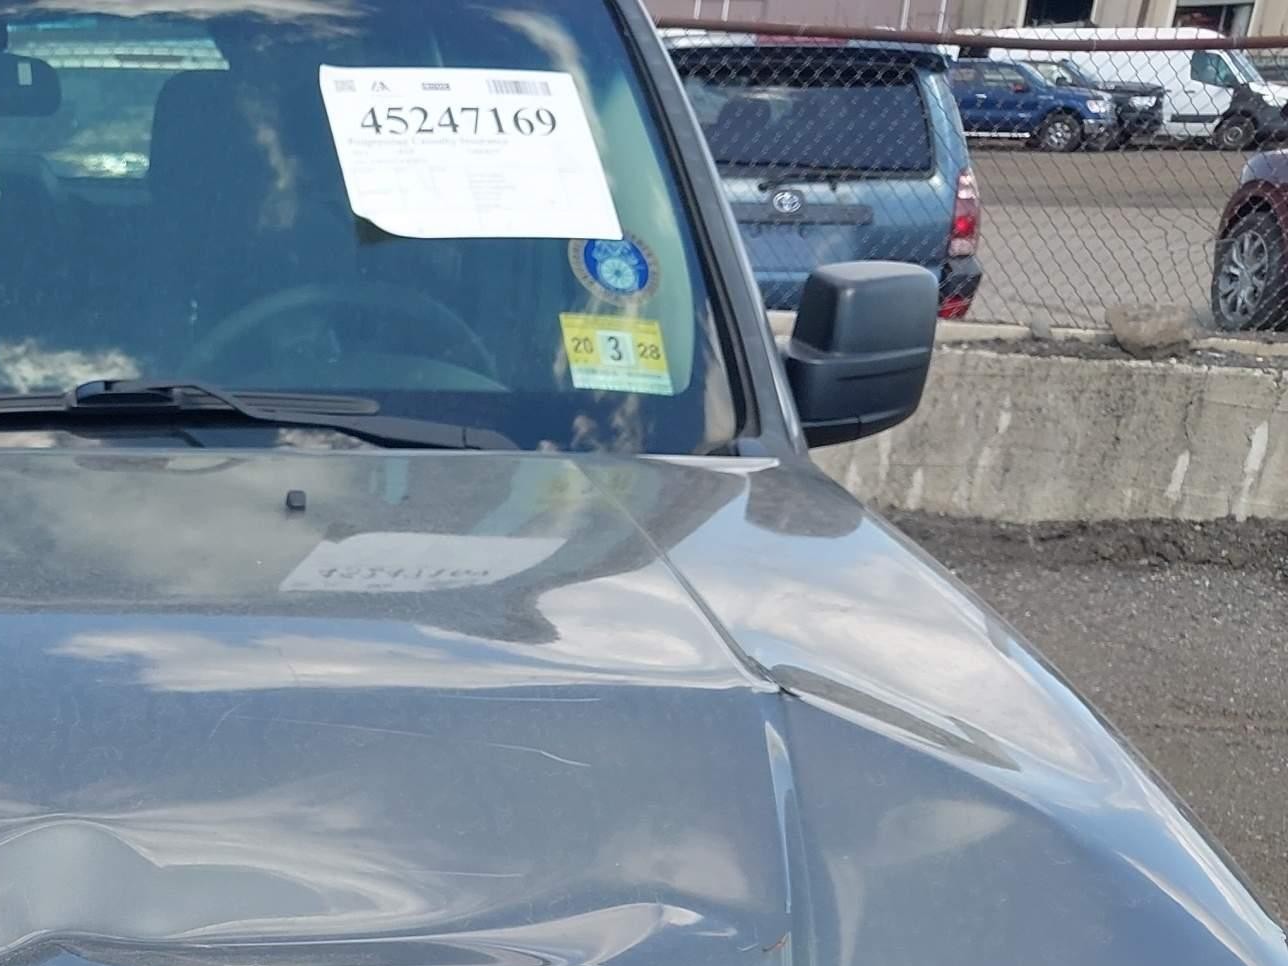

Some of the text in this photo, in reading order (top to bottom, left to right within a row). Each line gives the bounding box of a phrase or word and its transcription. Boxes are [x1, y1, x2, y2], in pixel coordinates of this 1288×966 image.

[360, 106, 557, 136] 45247169
[571, 336, 661, 361] 20 3 28
